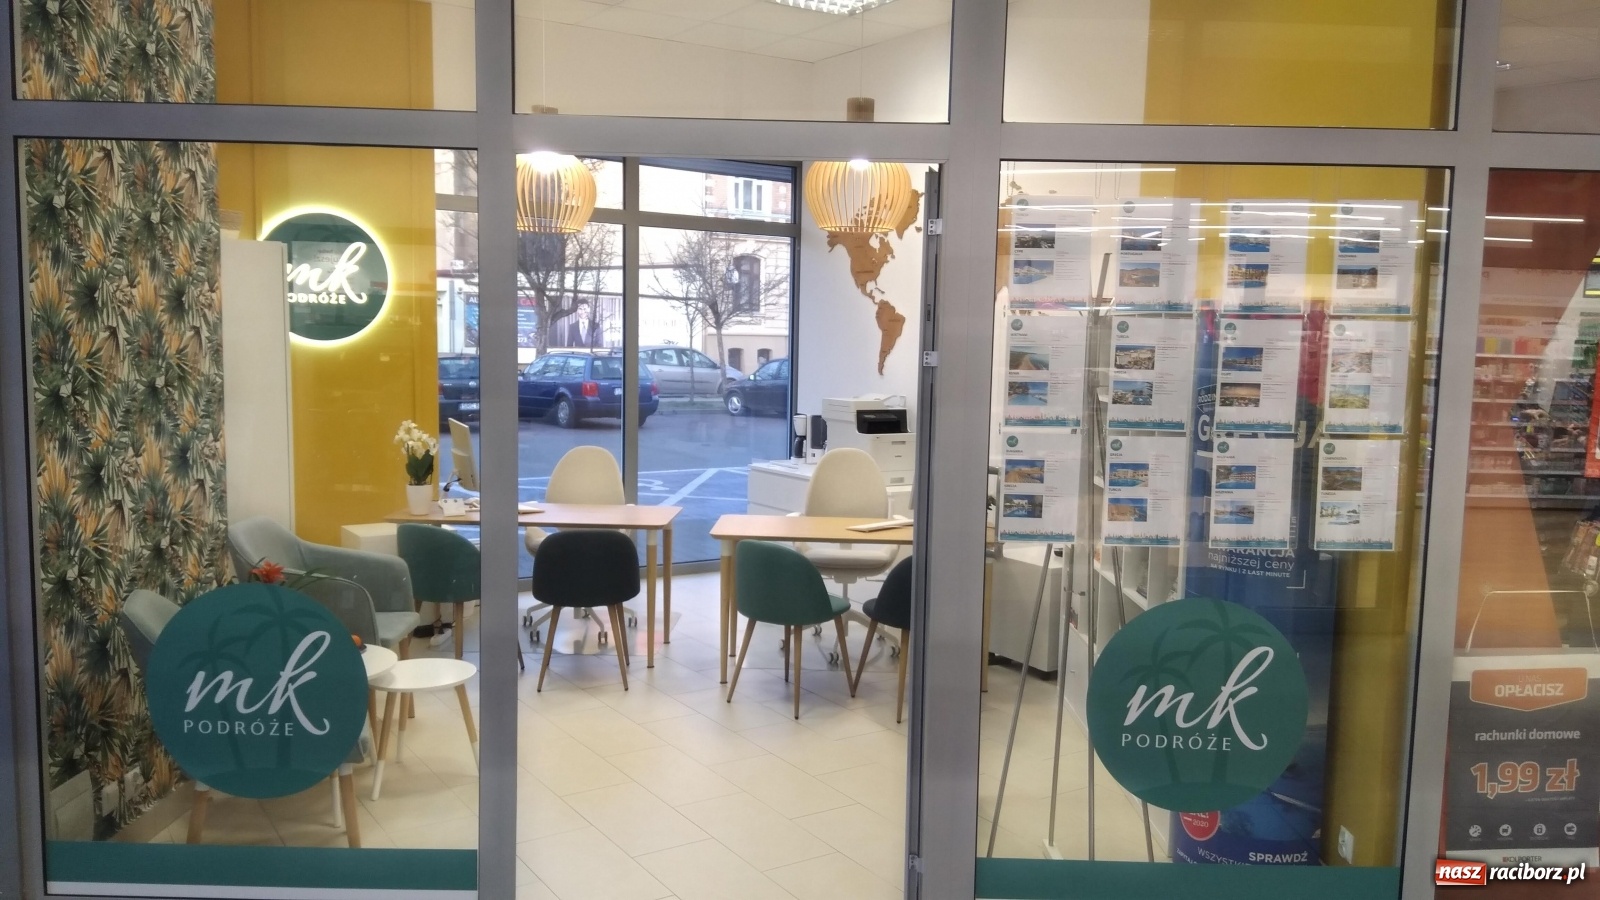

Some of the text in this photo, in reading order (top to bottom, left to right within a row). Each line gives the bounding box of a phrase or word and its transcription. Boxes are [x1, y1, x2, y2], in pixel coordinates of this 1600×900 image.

[287, 291, 347, 305] ODRÓŻE
[1208, 551, 1295, 571] najniższej ceny
[184, 630, 331, 735] mk
[1494, 683, 1564, 697] OPŁACISZ
[1123, 646, 1274, 750] mk
[183, 718, 294, 736] PODRÓŻE
[1474, 728, 1580, 741] rachunki domowe
[1121, 732, 1232, 750] PODRÓŻE
[1470, 758, 1580, 799] 1,99 zł
[1248, 850, 1308, 864] SPRAWDŹ
